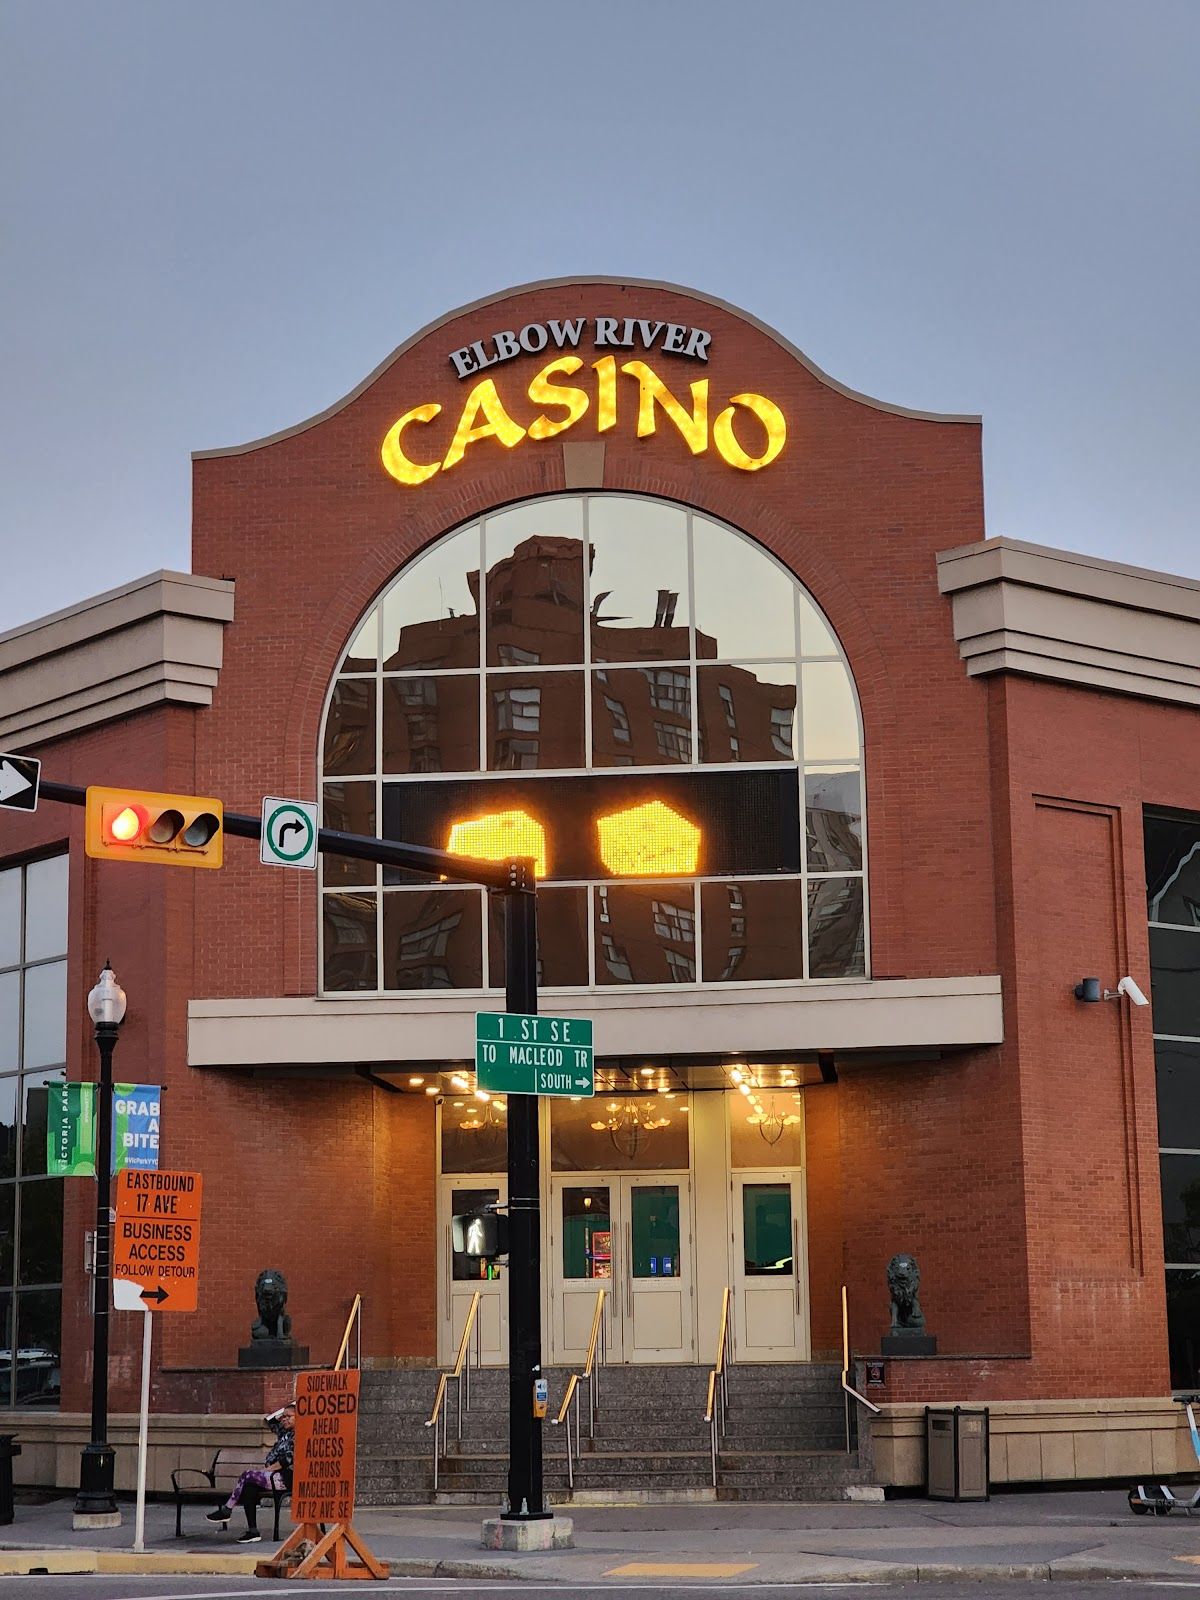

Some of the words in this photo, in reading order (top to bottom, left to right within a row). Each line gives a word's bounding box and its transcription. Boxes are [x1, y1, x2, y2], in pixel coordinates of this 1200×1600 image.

[449, 317, 587, 379] ELBOW
[595, 317, 712, 362] RIVER
[381, 355, 787, 485] CASINO
[498, 1017, 504, 1039] 1
[521, 1019, 538, 1041] ST
[551, 1020, 570, 1043] SE
[482, 1044, 496, 1063] TO
[509, 1046, 563, 1067] MACLEOD
[574, 1050, 588, 1068] TR
[540, 1073, 572, 1090] SOUTH
[61, 1082, 70, 1112] PARK
[115, 1099, 160, 1117] GRAB
[147, 1118, 159, 1133] A
[123, 1132, 159, 1149] BITE
[127, 1172, 194, 1192] EASTBOUND
[137, 1193, 149, 1212] 17
[153, 1194, 178, 1214] AVE
[123, 1222, 192, 1242] BUSINESS
[128, 1243, 185, 1262] ACCESS
[115, 1263, 154, 1276] FOLLOW
[158, 1265, 195, 1278] DETOUR
[306, 1374, 348, 1393] SIDEWALK
[297, 1394, 356, 1416] CLOSED
[312, 1417, 339, 1435] AHEAD
[305, 1437, 344, 1459] ACCESS
[308, 1460, 341, 1478] ACROSS
[298, 1480, 336, 1498] MACLEOD
[339, 1480, 349, 1498] TR
[296, 1501, 306, 1518] AT
[308, 1501, 317, 1518] 12
[320, 1501, 335, 1518] AVE
[338, 1501, 349, 1518] SE
